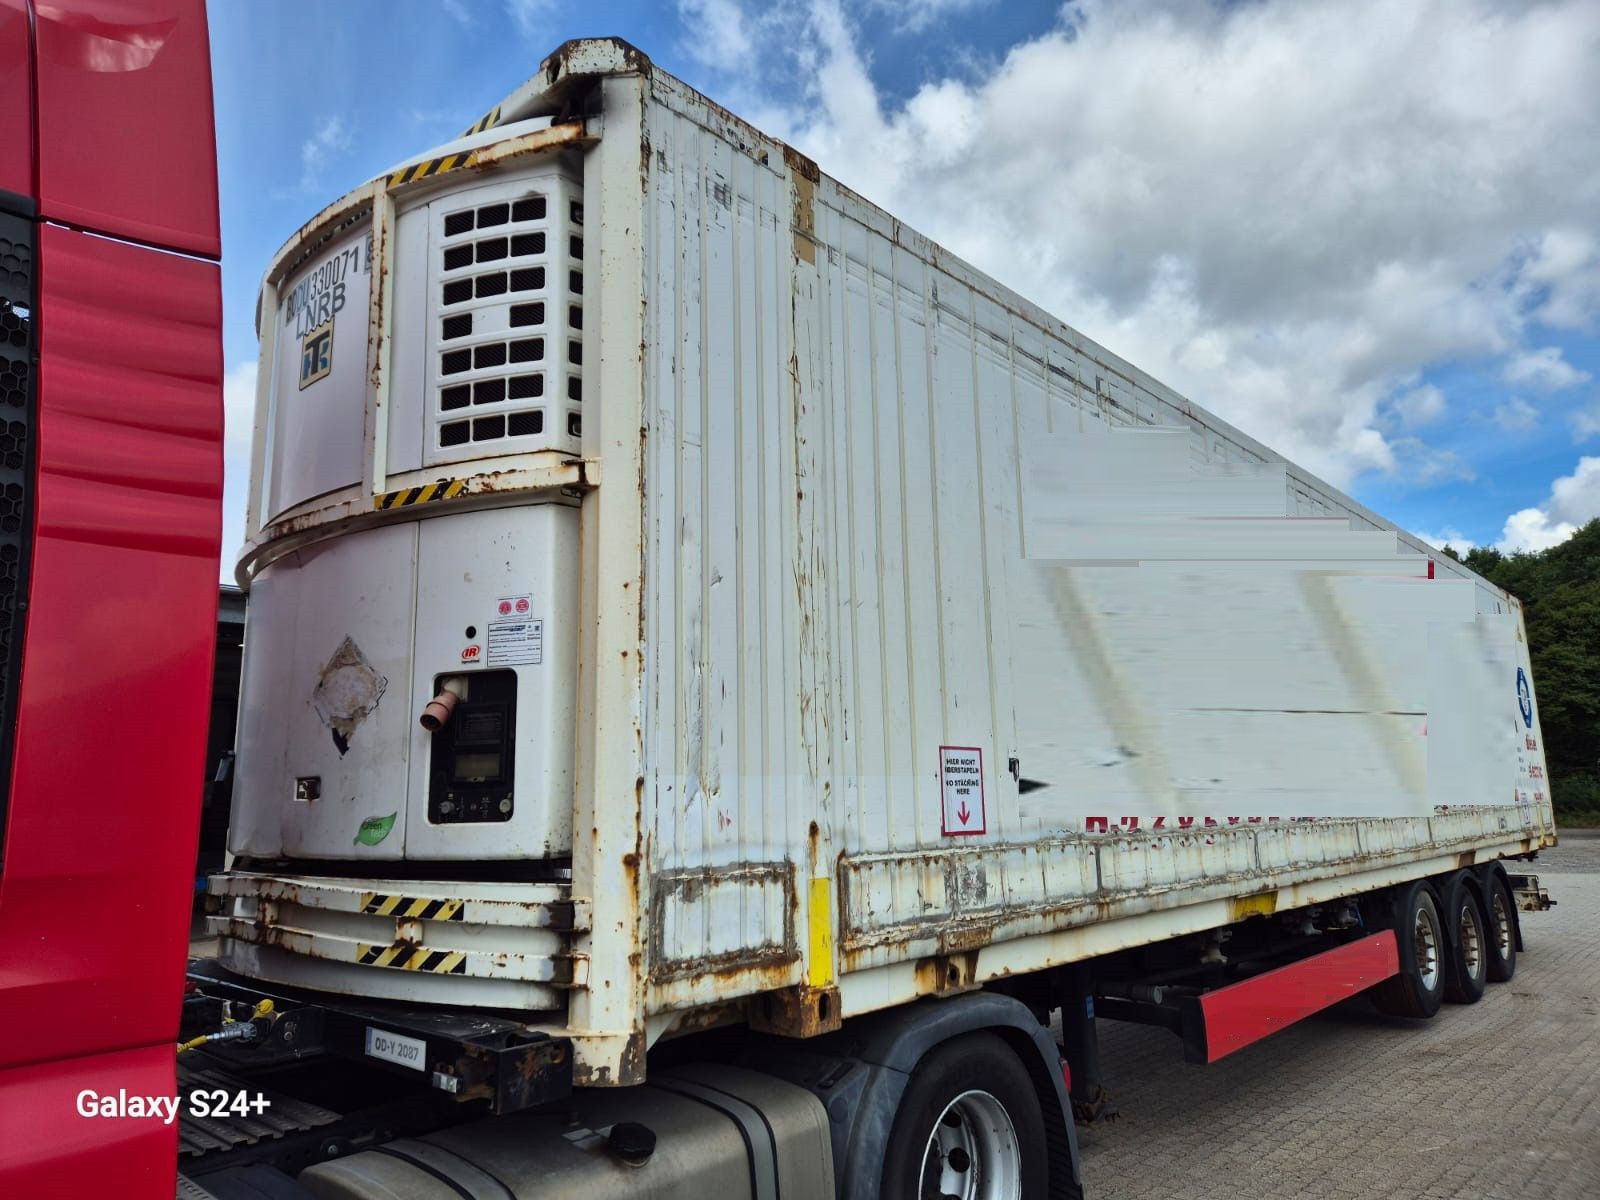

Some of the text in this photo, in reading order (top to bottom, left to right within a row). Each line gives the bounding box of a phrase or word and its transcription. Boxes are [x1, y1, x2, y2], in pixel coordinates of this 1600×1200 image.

[310, 246, 359, 301] 330071
[296, 282, 346, 340] LNRB
[397, 1043, 419, 1061] 2087
